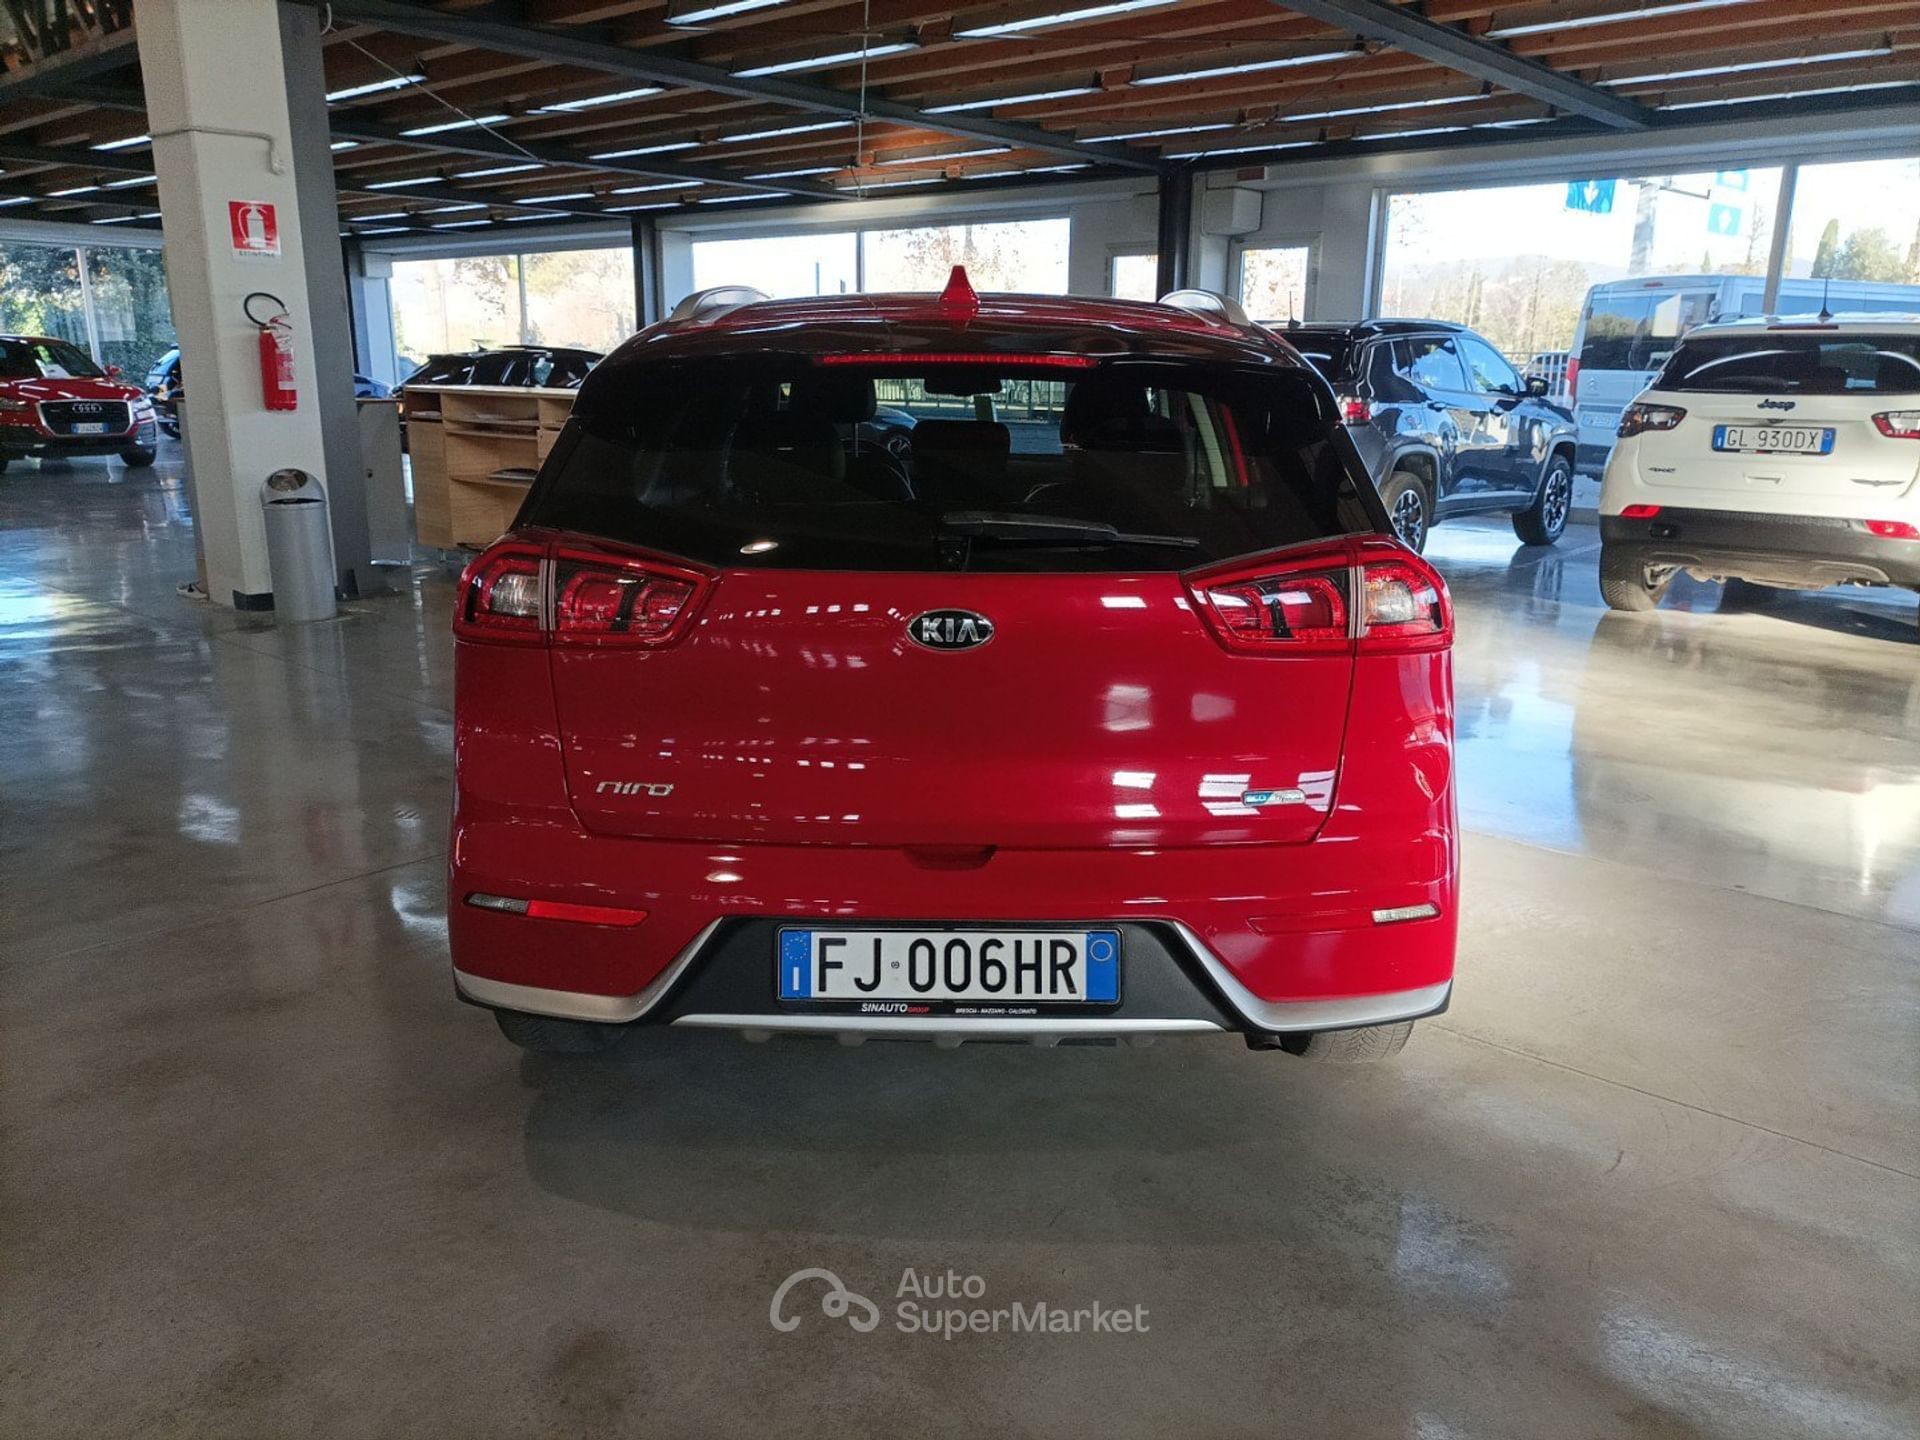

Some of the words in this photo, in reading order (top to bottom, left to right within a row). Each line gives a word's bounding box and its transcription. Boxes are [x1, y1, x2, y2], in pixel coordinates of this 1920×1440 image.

[1757, 398, 1796, 412] Jeep
[1727, 429, 1748, 447] GL
[1758, 430, 1818, 449] 930DX
[921, 617, 980, 643] KIA
[818, 938, 883, 993] FJ
[908, 938, 1078, 995] 006HR
